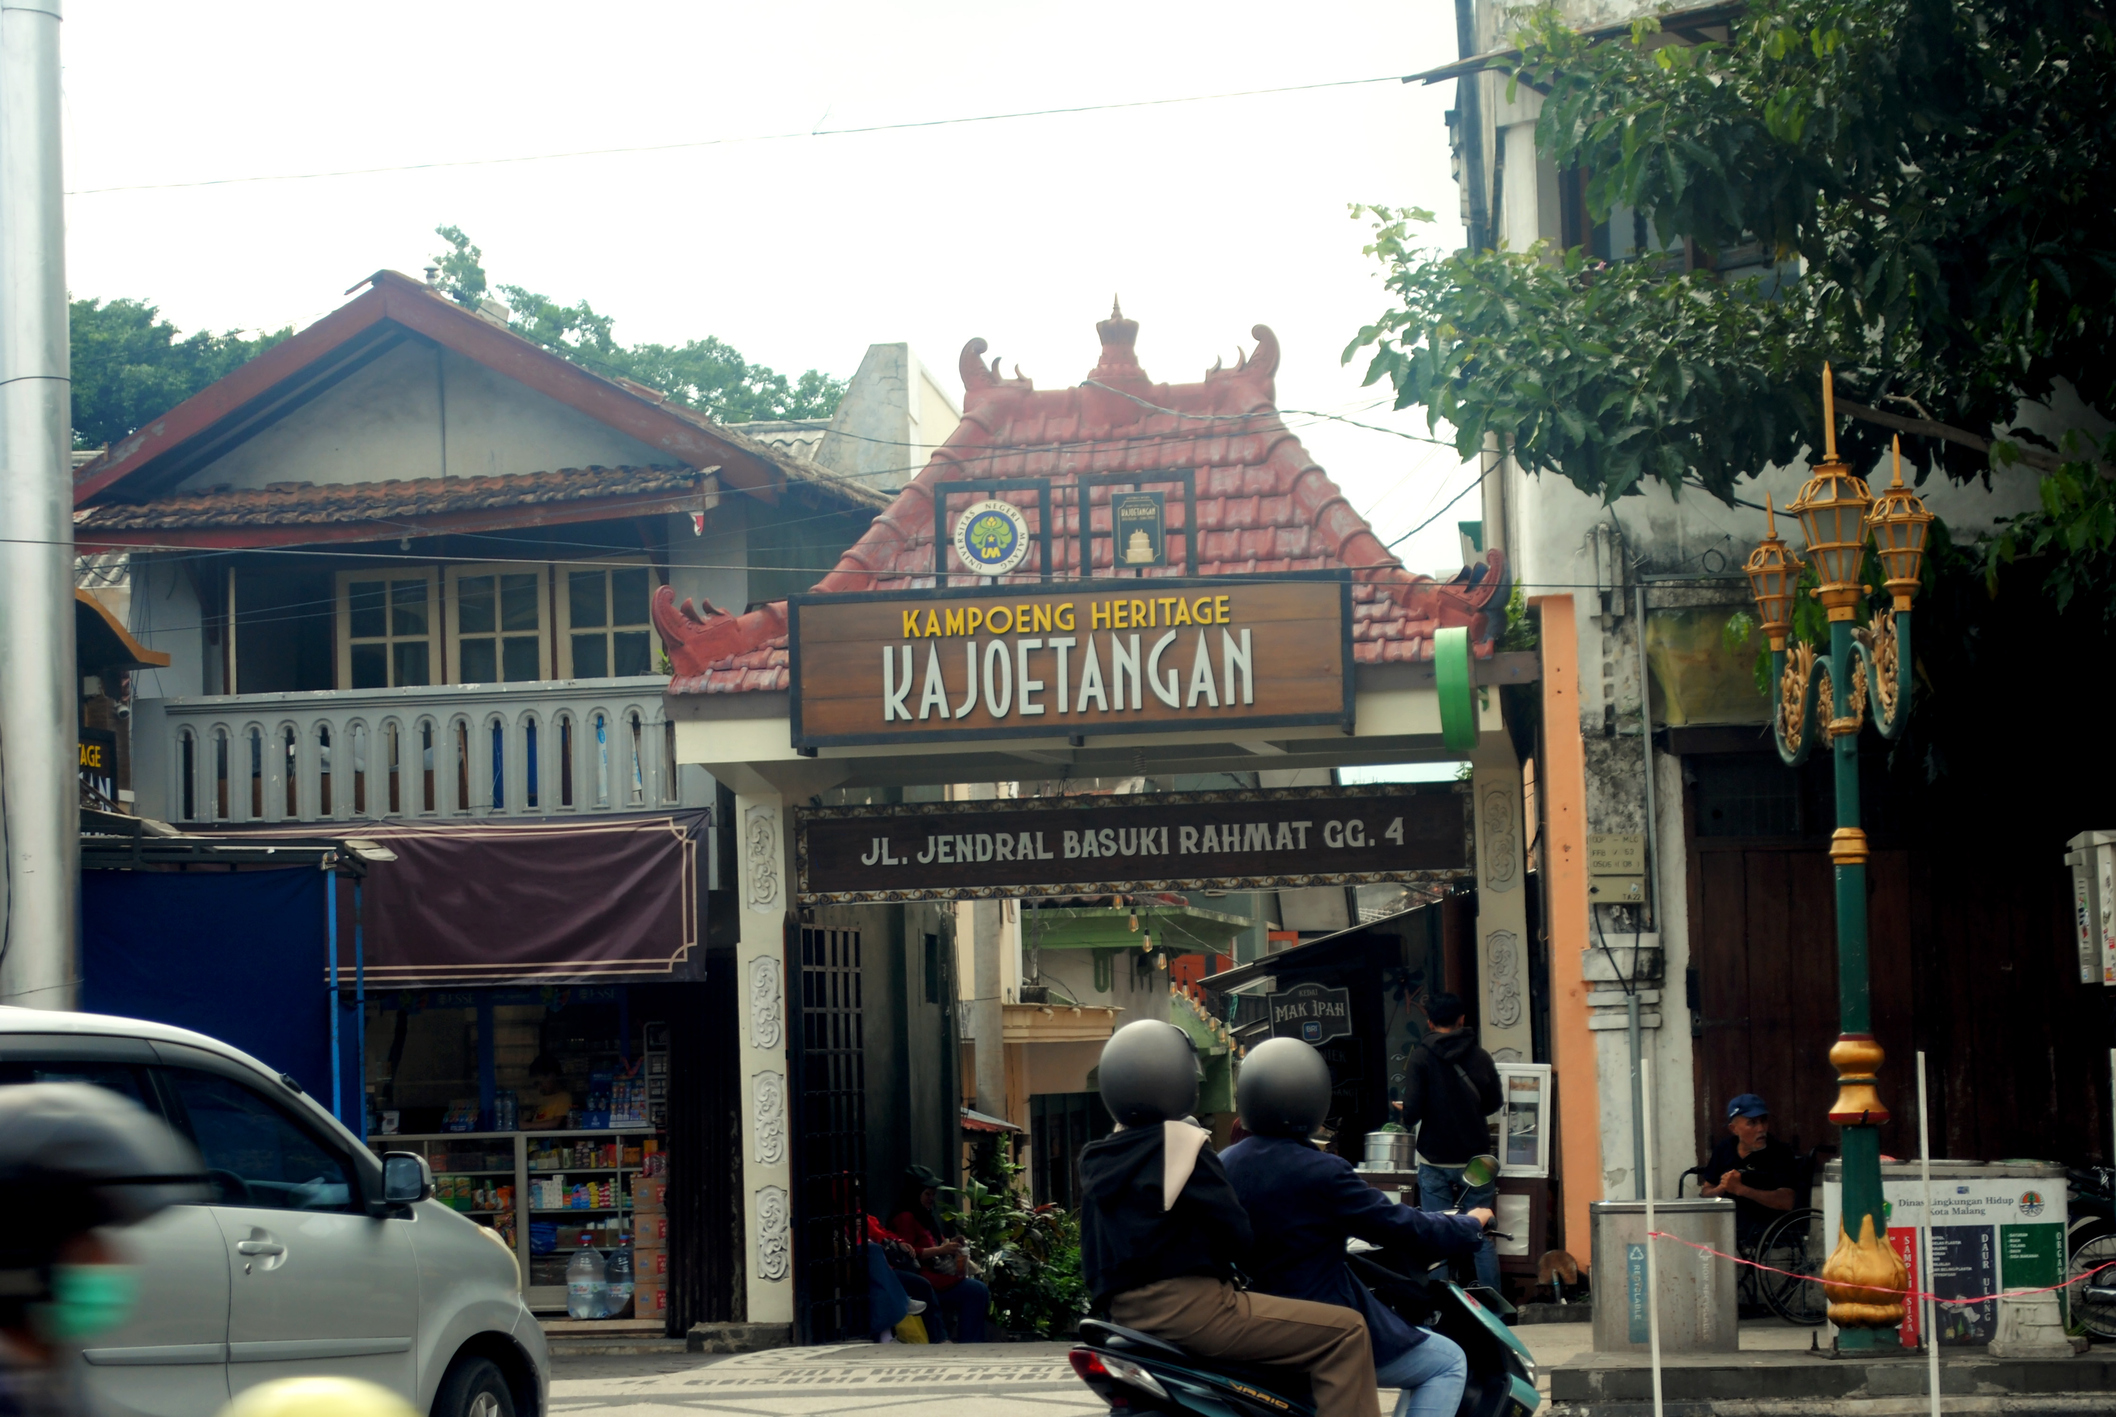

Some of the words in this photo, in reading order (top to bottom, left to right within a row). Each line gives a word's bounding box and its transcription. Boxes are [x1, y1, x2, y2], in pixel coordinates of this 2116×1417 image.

[985, 502, 1020, 522] NEGERI
[958, 509, 982, 570] UNIVERSITAS
[981, 546, 1002, 559] UM
[1001, 532, 1026, 570] MALANG
[902, 602, 1076, 639] KAMPOENG
[1091, 595, 1231, 631] HERITAGE
[883, 628, 1255, 722] KAJOETANGAN
[861, 837, 909, 867] JL.
[917, 831, 1053, 866] JENDRAL
[1063, 826, 1170, 860] BASUKI
[1179, 820, 1312, 855] RAHMAT
[1323, 818, 1376, 848] GG.
[1384, 817, 1405, 846] 4
[1299, 989, 1318, 997] KEDAI
[1275, 1002, 1307, 1023] MAK
[1313, 1000, 1346, 1017] IPAH
[1899, 1199, 1925, 1207] Dinas
[1986, 1196, 2014, 1206] Hidup
[1952, 1206, 1986, 1216] Malang
[1981, 1234, 1990, 1269] DAUR
[1633, 1264, 1642, 1320] RECYCLABLE
[1906, 1297, 1914, 1332] SISA
